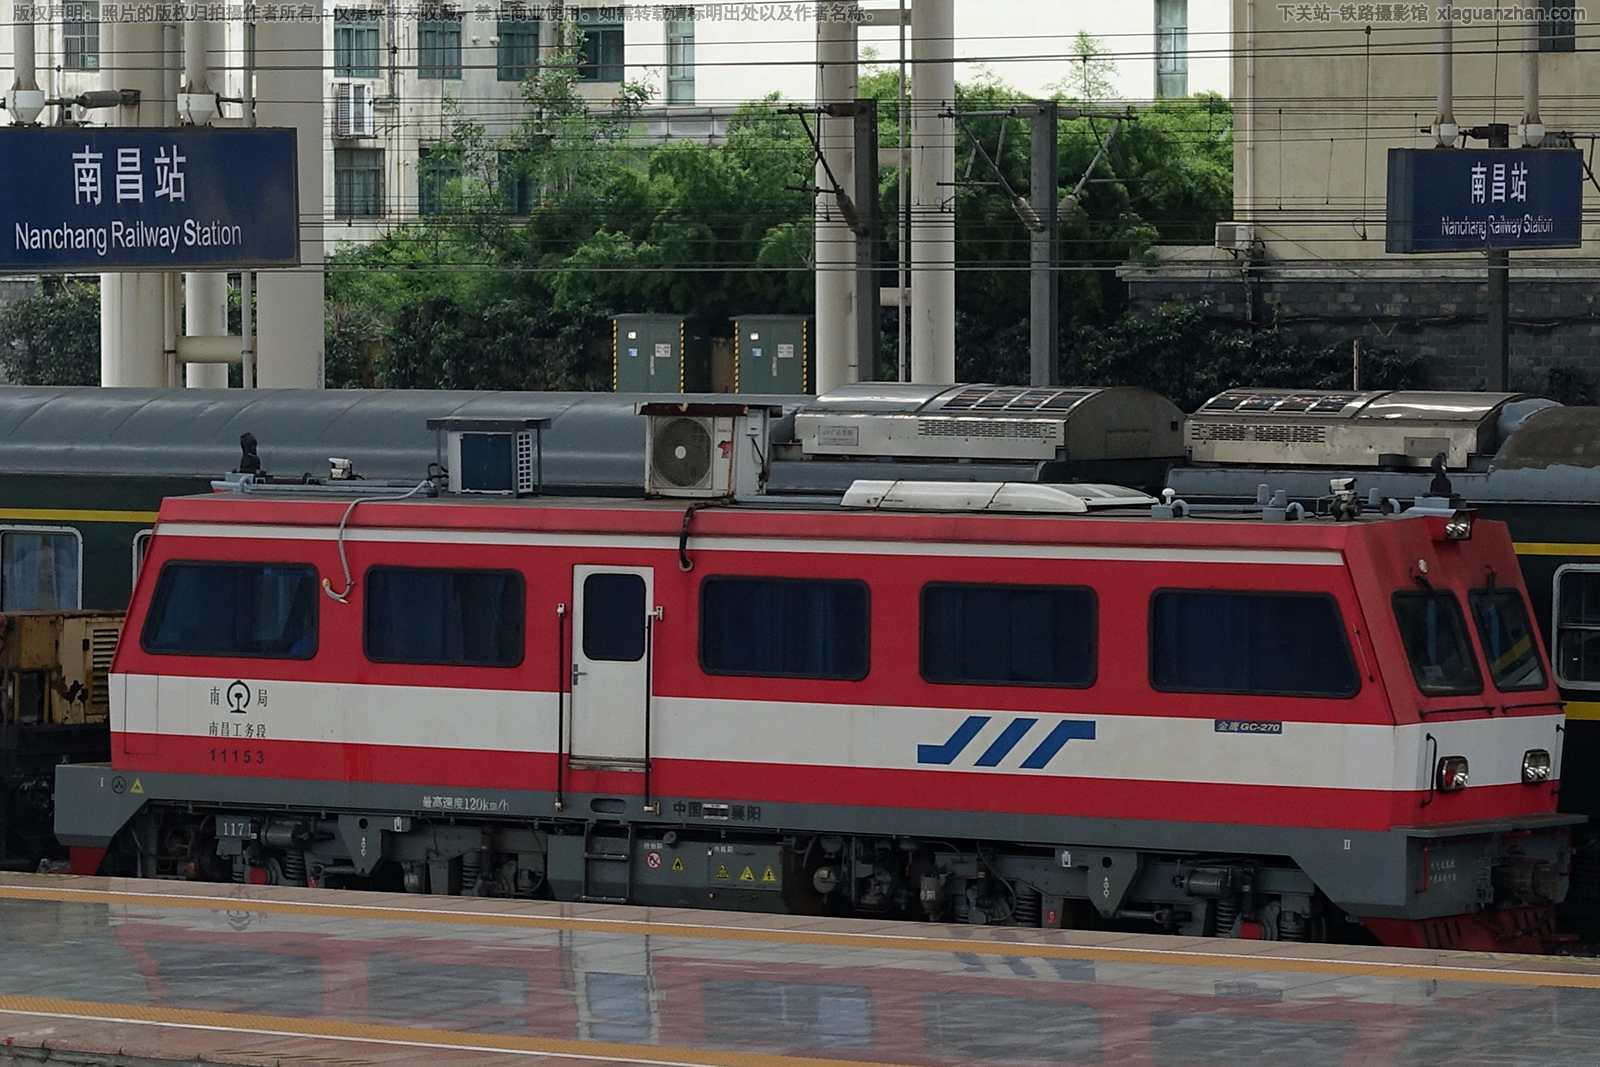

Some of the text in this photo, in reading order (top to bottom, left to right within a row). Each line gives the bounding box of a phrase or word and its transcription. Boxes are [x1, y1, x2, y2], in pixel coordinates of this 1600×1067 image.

[72, 144, 187, 206] 南昌站
[1470, 161, 1529, 204] 南昌站
[1441, 213, 1553, 240] Nanchang Railway Station
[15, 218, 242, 256] Nanchang Railway Station
[210, 686, 268, 707] 南 局
[209, 721, 267, 739] 南昌工务段
[1240, 722, 1280, 732] GC-270
[210, 748, 265, 765] 11153
[422, 796, 510, 812] 最高速度120km/h
[673, 801, 702, 818] 中国
[223, 822, 252, 837] 1171
